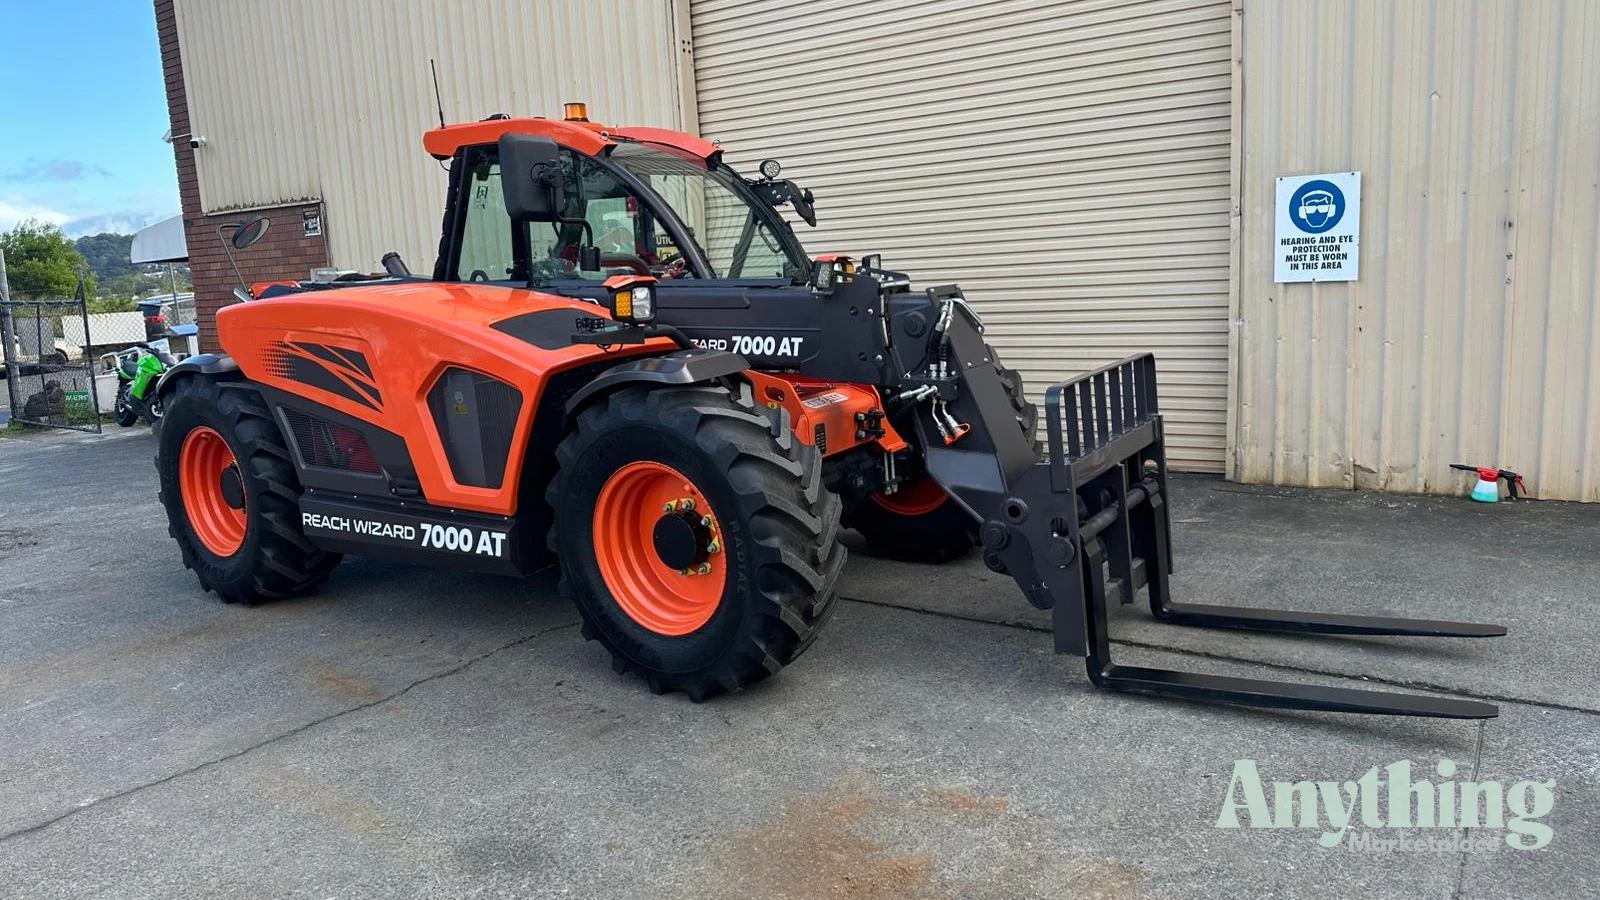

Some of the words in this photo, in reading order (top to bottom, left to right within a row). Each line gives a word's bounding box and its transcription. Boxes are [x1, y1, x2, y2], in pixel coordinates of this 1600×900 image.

[1281, 237, 1316, 246] HEARING
[1318, 236, 1336, 244] AND
[1339, 235, 1353, 243] EYE
[1293, 244, 1340, 253] PROTECTION
[1285, 254, 1307, 262] MUST
[1309, 253, 1320, 261] BE
[1322, 252, 1348, 261] WORN
[1290, 262, 1299, 271] IN
[1301, 262, 1319, 270] THIS
[1320, 261, 1342, 270] AREA
[731, 335, 776, 356] 7000
[776, 337, 804, 357] AT
[302, 512, 350, 532] REACH
[353, 518, 415, 541] WIZARD
[420, 523, 473, 553] 7000
[475, 530, 506, 557] AT
